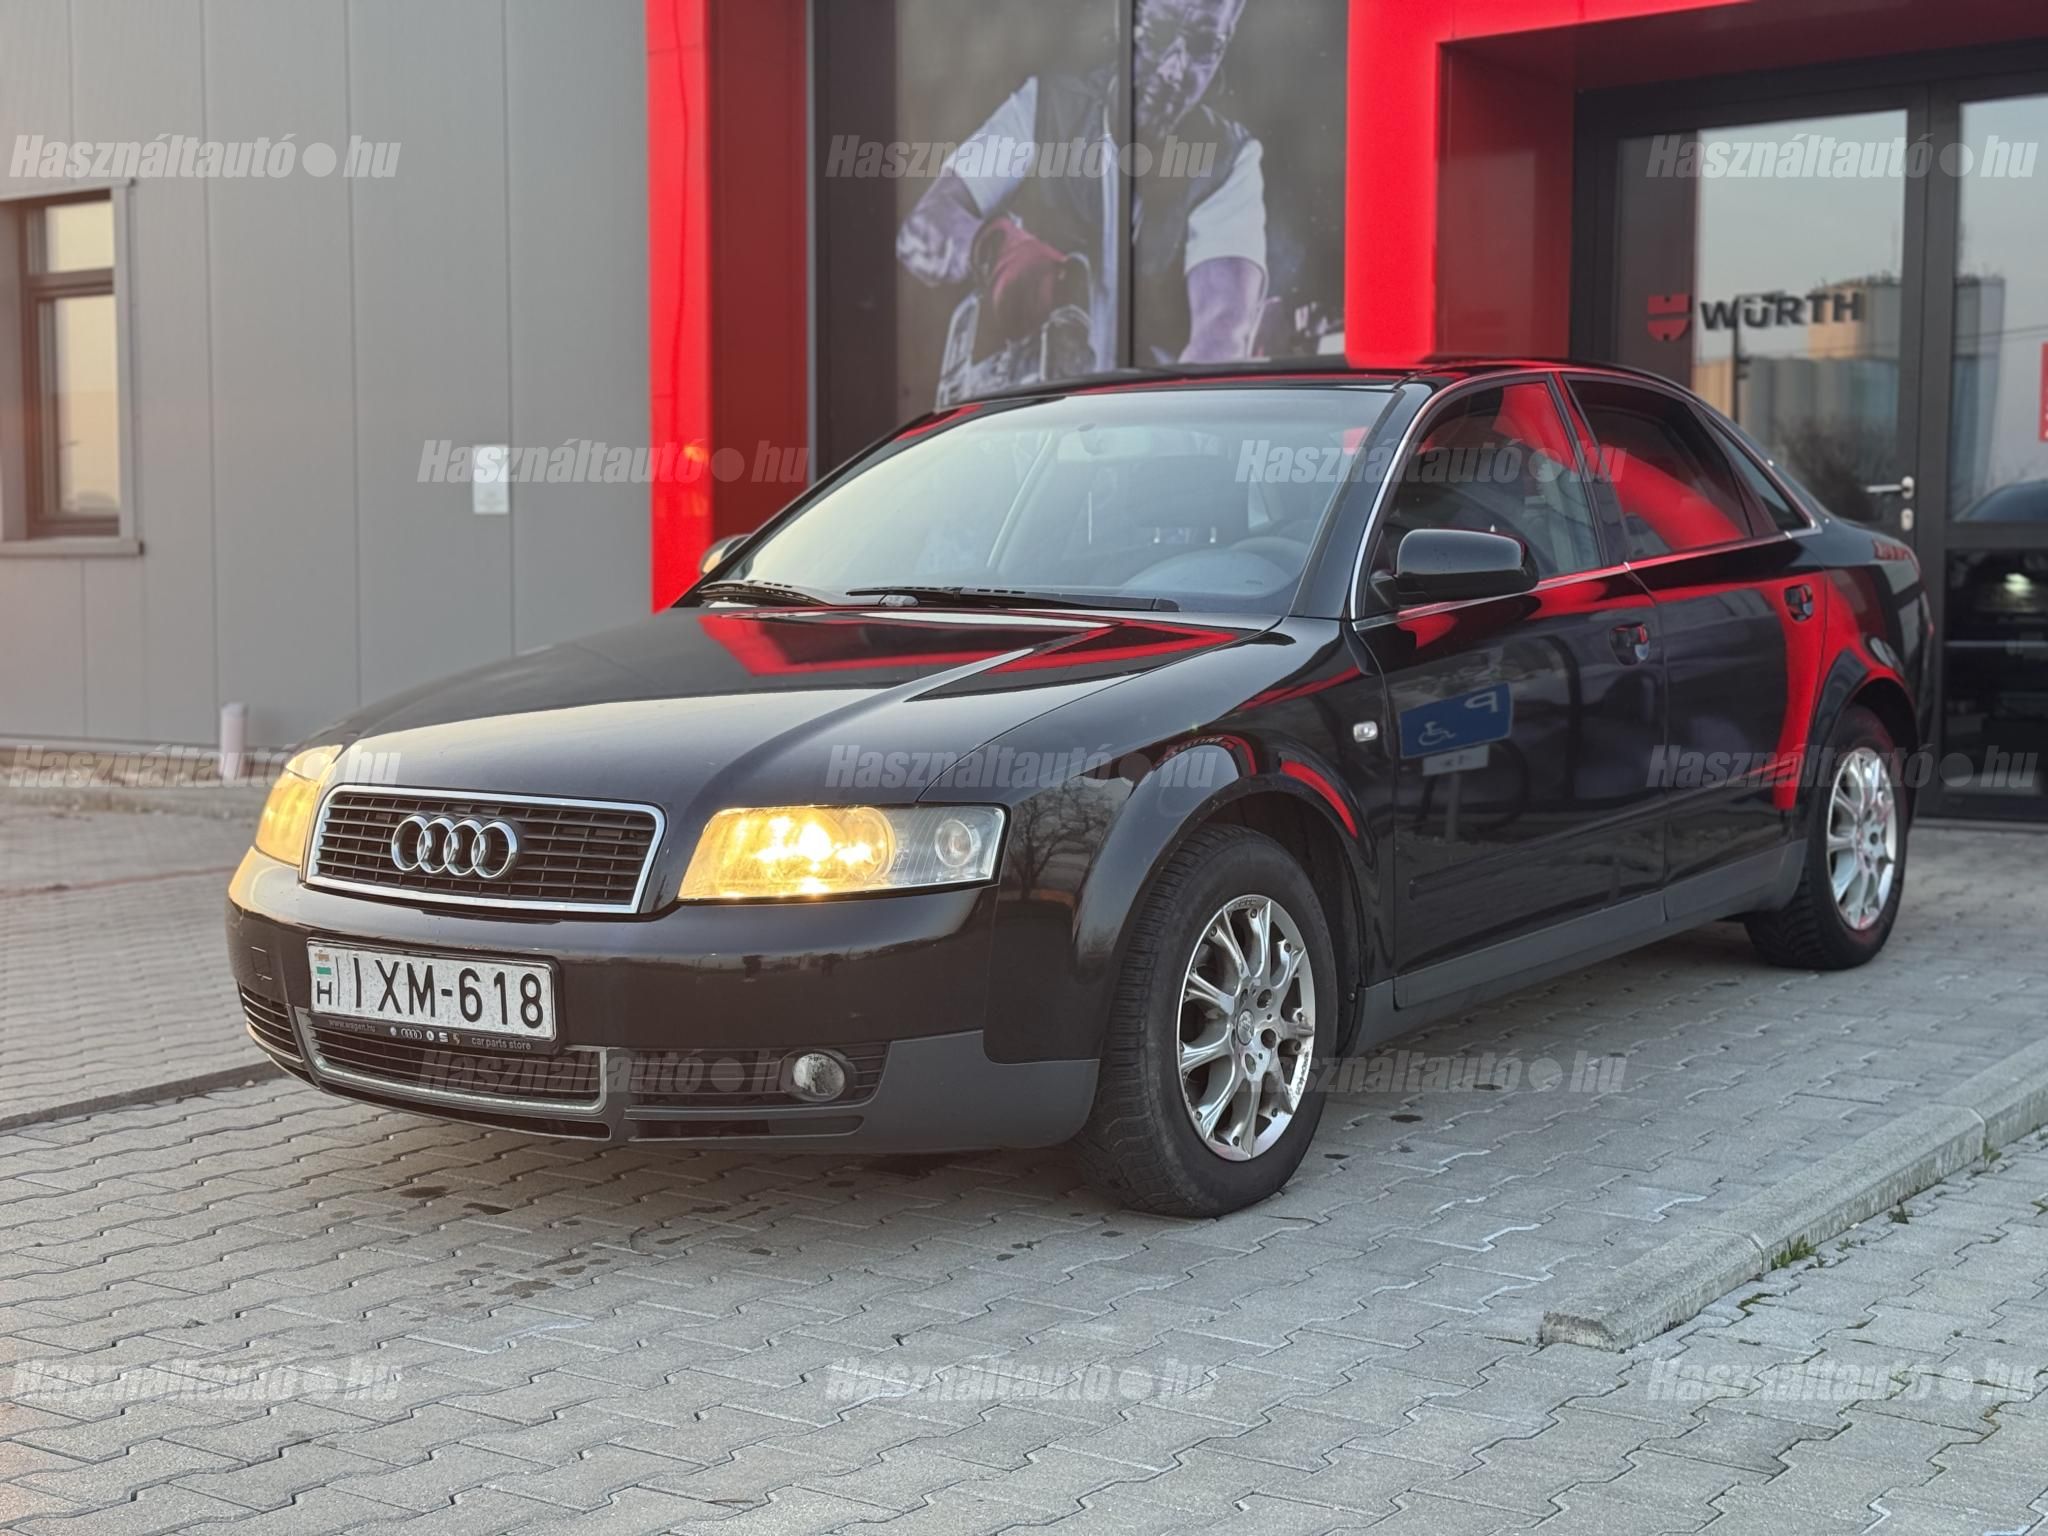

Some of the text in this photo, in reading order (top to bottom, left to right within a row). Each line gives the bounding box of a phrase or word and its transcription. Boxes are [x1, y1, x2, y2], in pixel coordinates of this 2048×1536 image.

[1700, 293, 1864, 331] WÜRTH
[316, 980, 333, 1006] H
[352, 956, 544, 1029] IXM-618
[471, 1037, 532, 1050] car parts store
